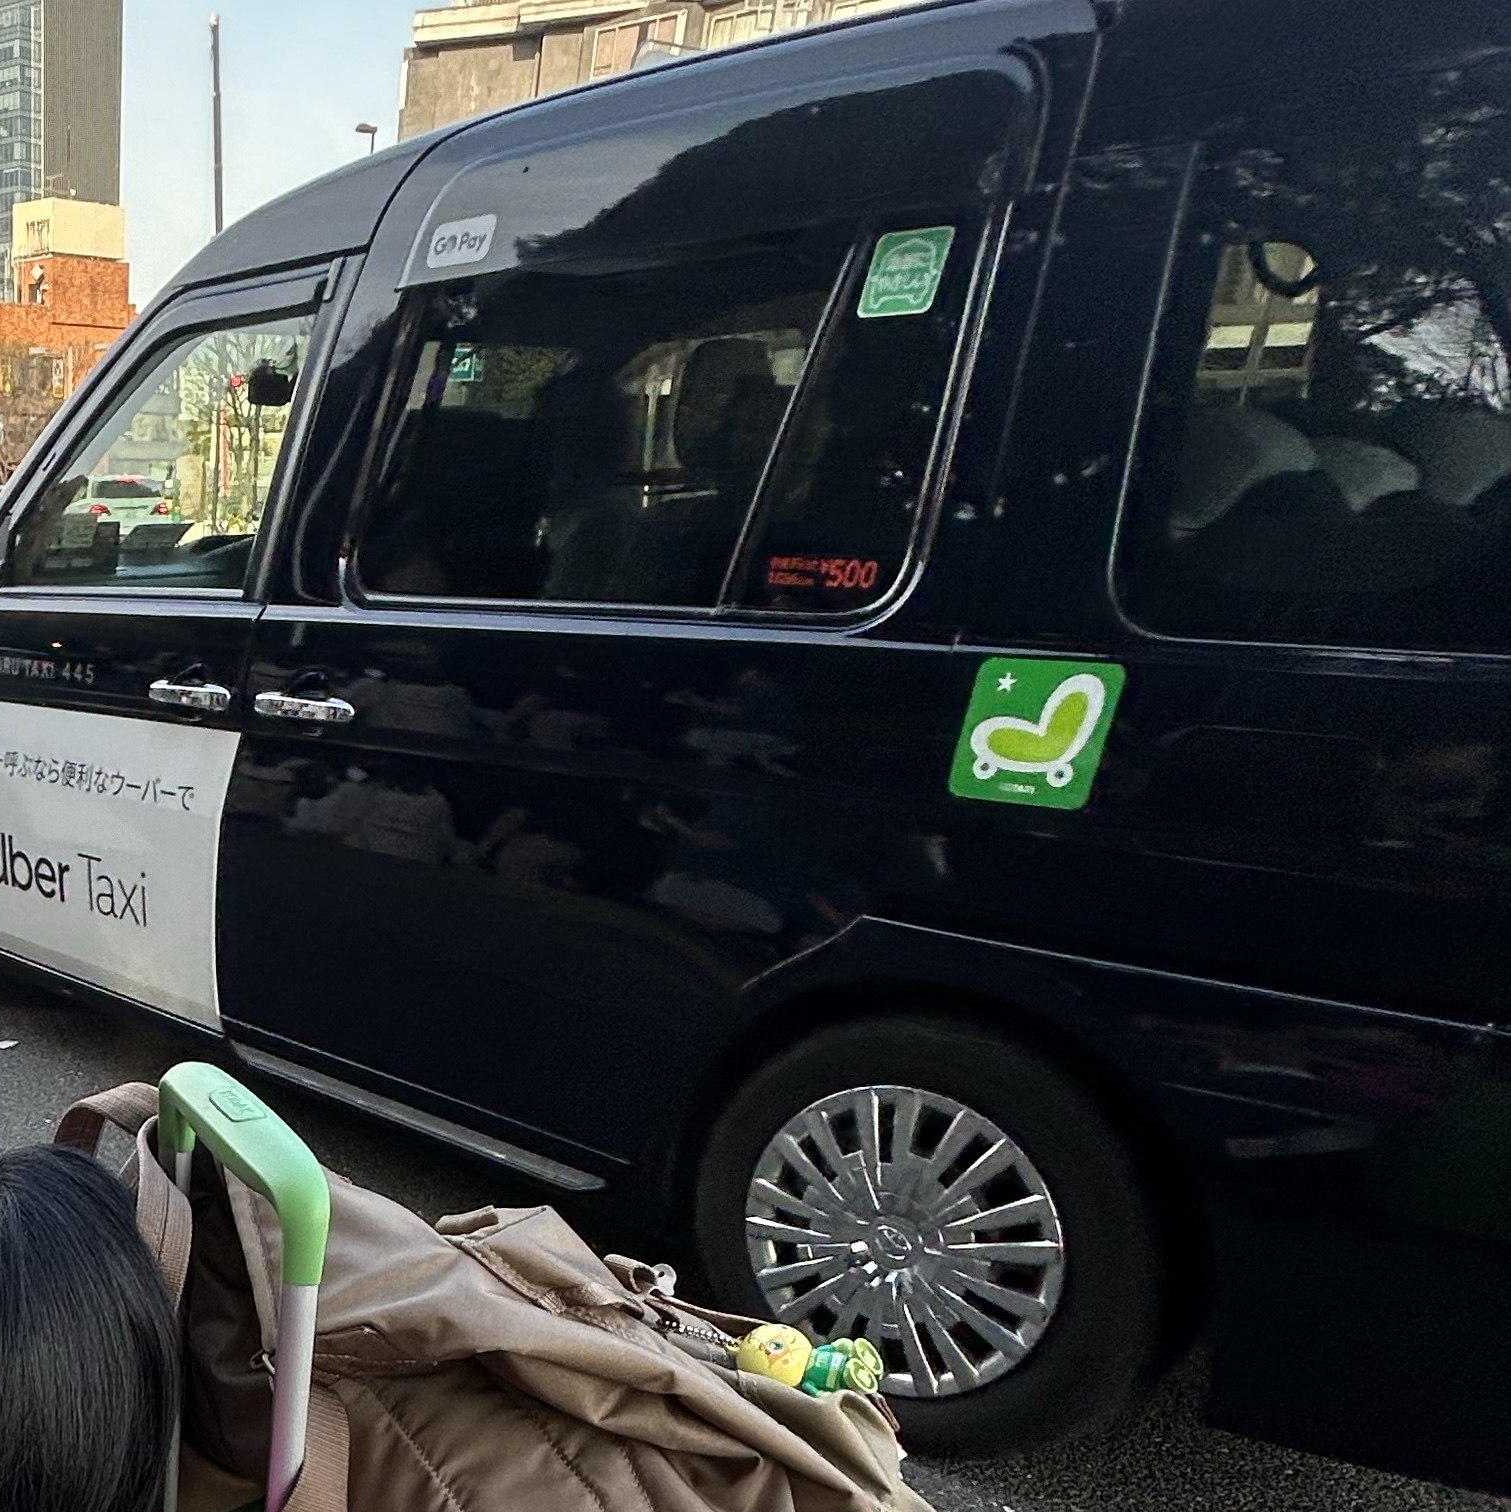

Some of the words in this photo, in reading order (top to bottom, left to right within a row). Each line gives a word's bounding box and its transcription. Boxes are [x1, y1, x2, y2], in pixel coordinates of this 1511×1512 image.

[458, 231, 488, 253] Pay
[23, 659, 55, 680] TAXI
[61, 662, 95, 685] 445
[77, 852, 148, 928] Taxi
